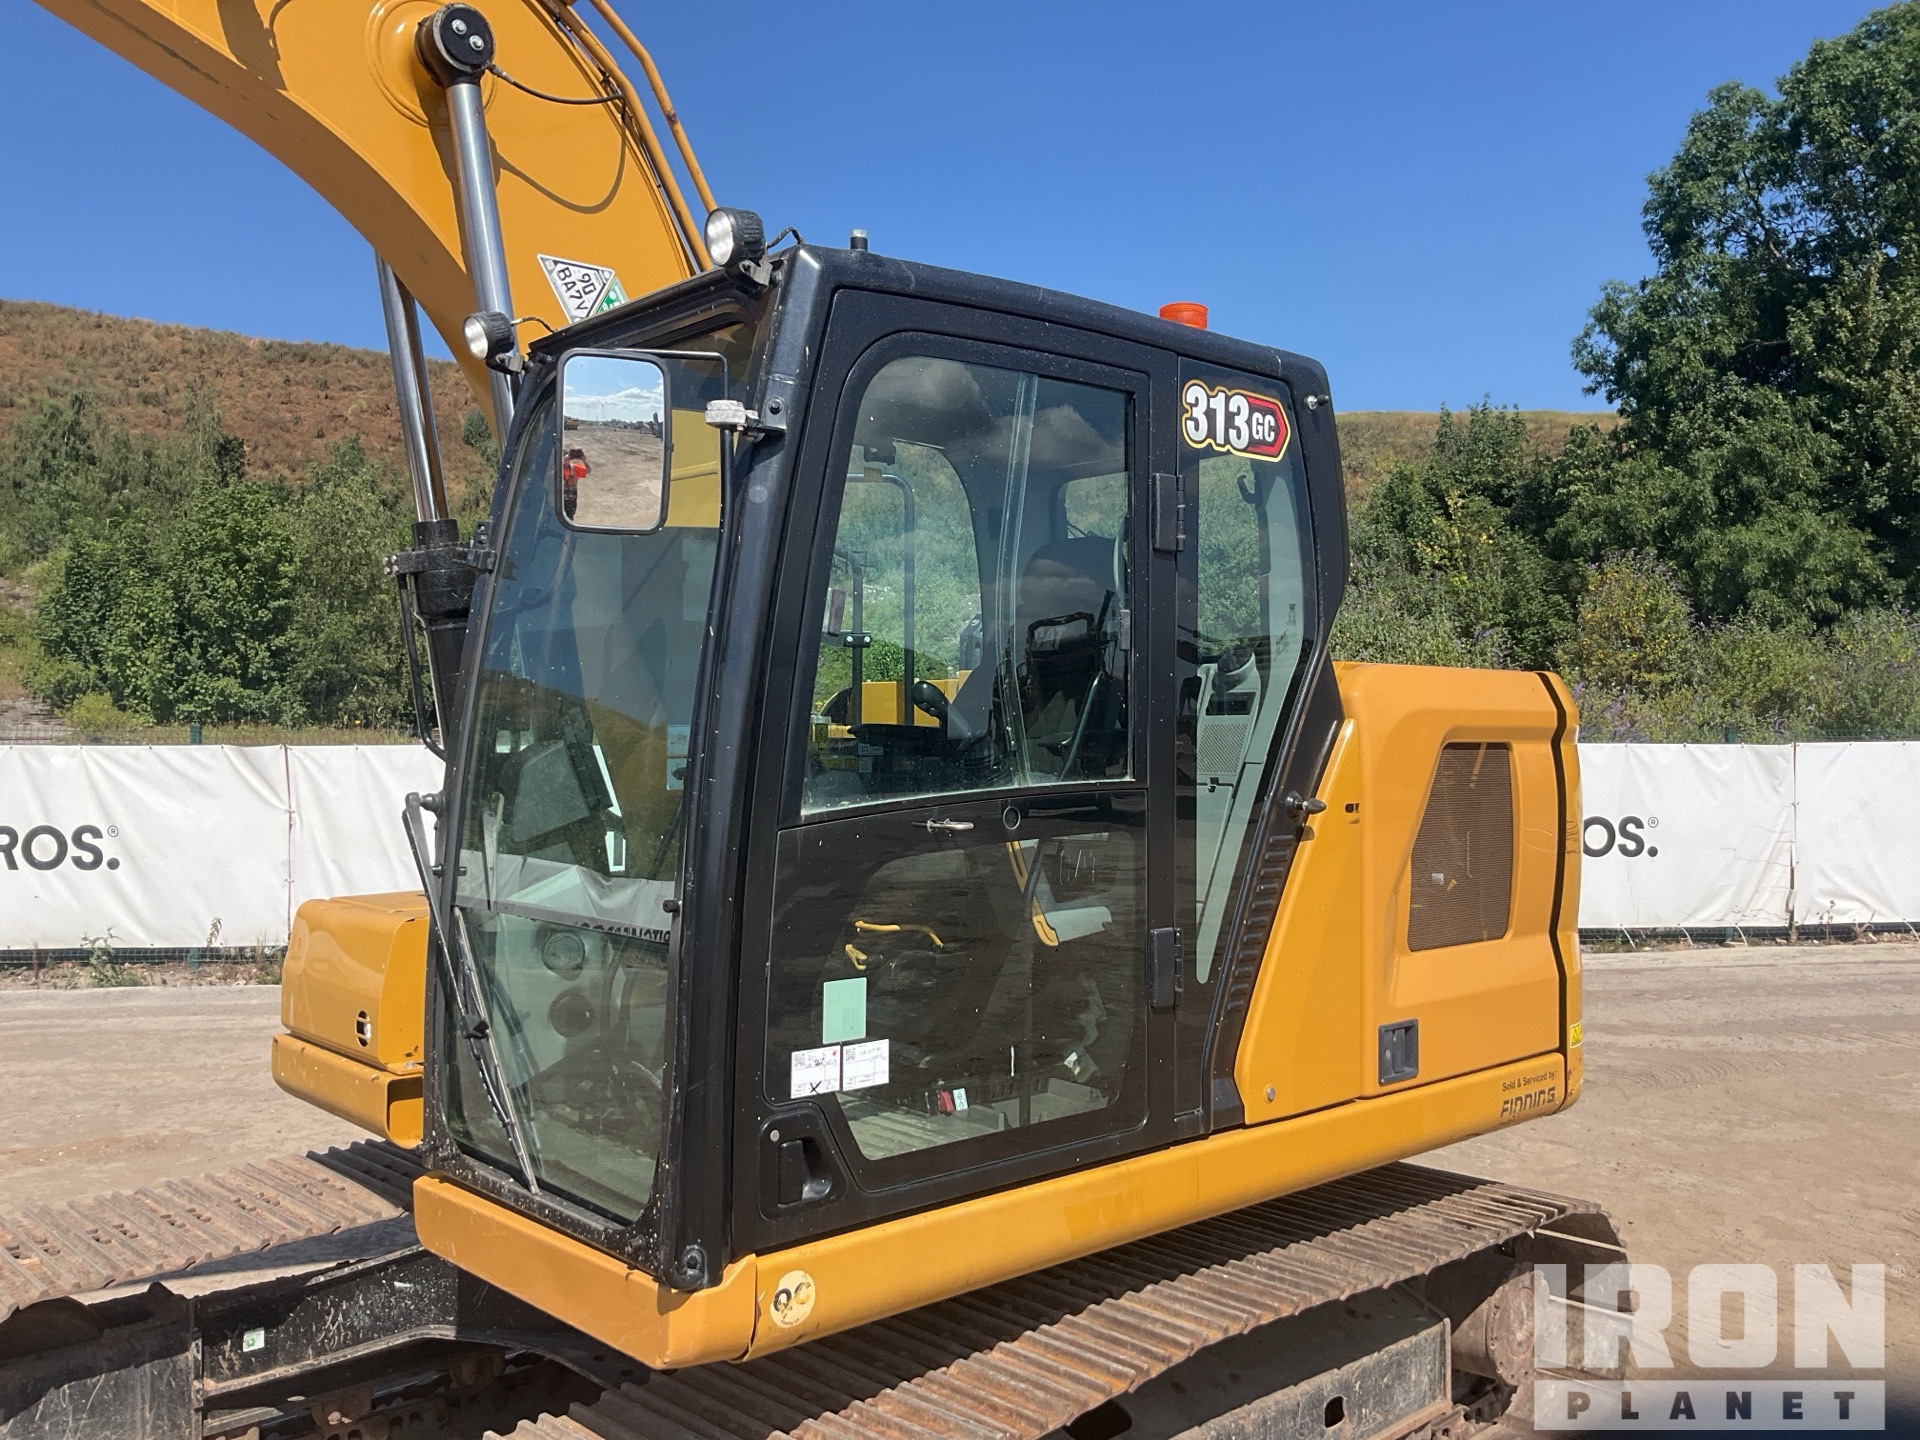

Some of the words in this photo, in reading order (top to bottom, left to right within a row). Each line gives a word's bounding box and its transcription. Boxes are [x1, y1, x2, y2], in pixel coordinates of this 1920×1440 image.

[1185, 384, 1250, 450] 313
[1251, 411, 1276, 443] GC
[1502, 1081, 1516, 1092] Sold
[1516, 1078, 1522, 1089] &
[1523, 1070, 1548, 1087] Serviced
[1500, 1086, 1557, 1118] FINNING
